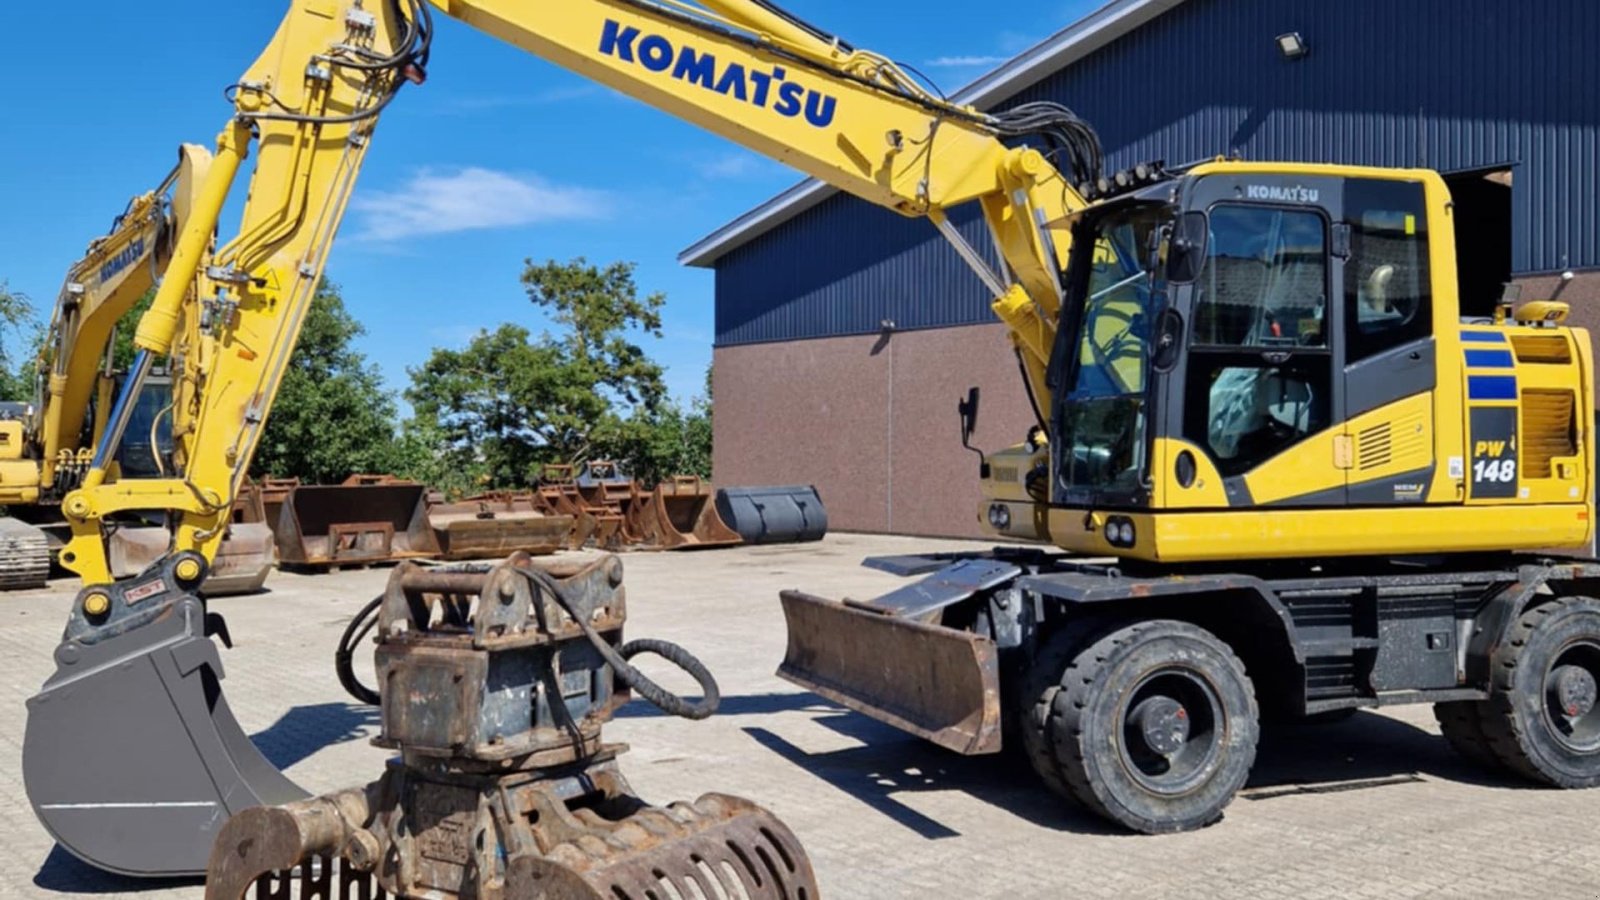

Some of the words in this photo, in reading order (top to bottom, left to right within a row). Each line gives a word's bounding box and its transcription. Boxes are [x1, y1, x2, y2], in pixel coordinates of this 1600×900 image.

[599, 19, 837, 127] KOMATSU
[1247, 185, 1319, 202] KOMATSU
[101, 238, 144, 283] KOMATSU
[1475, 440, 1506, 457] PW
[1473, 459, 1515, 482] 148
